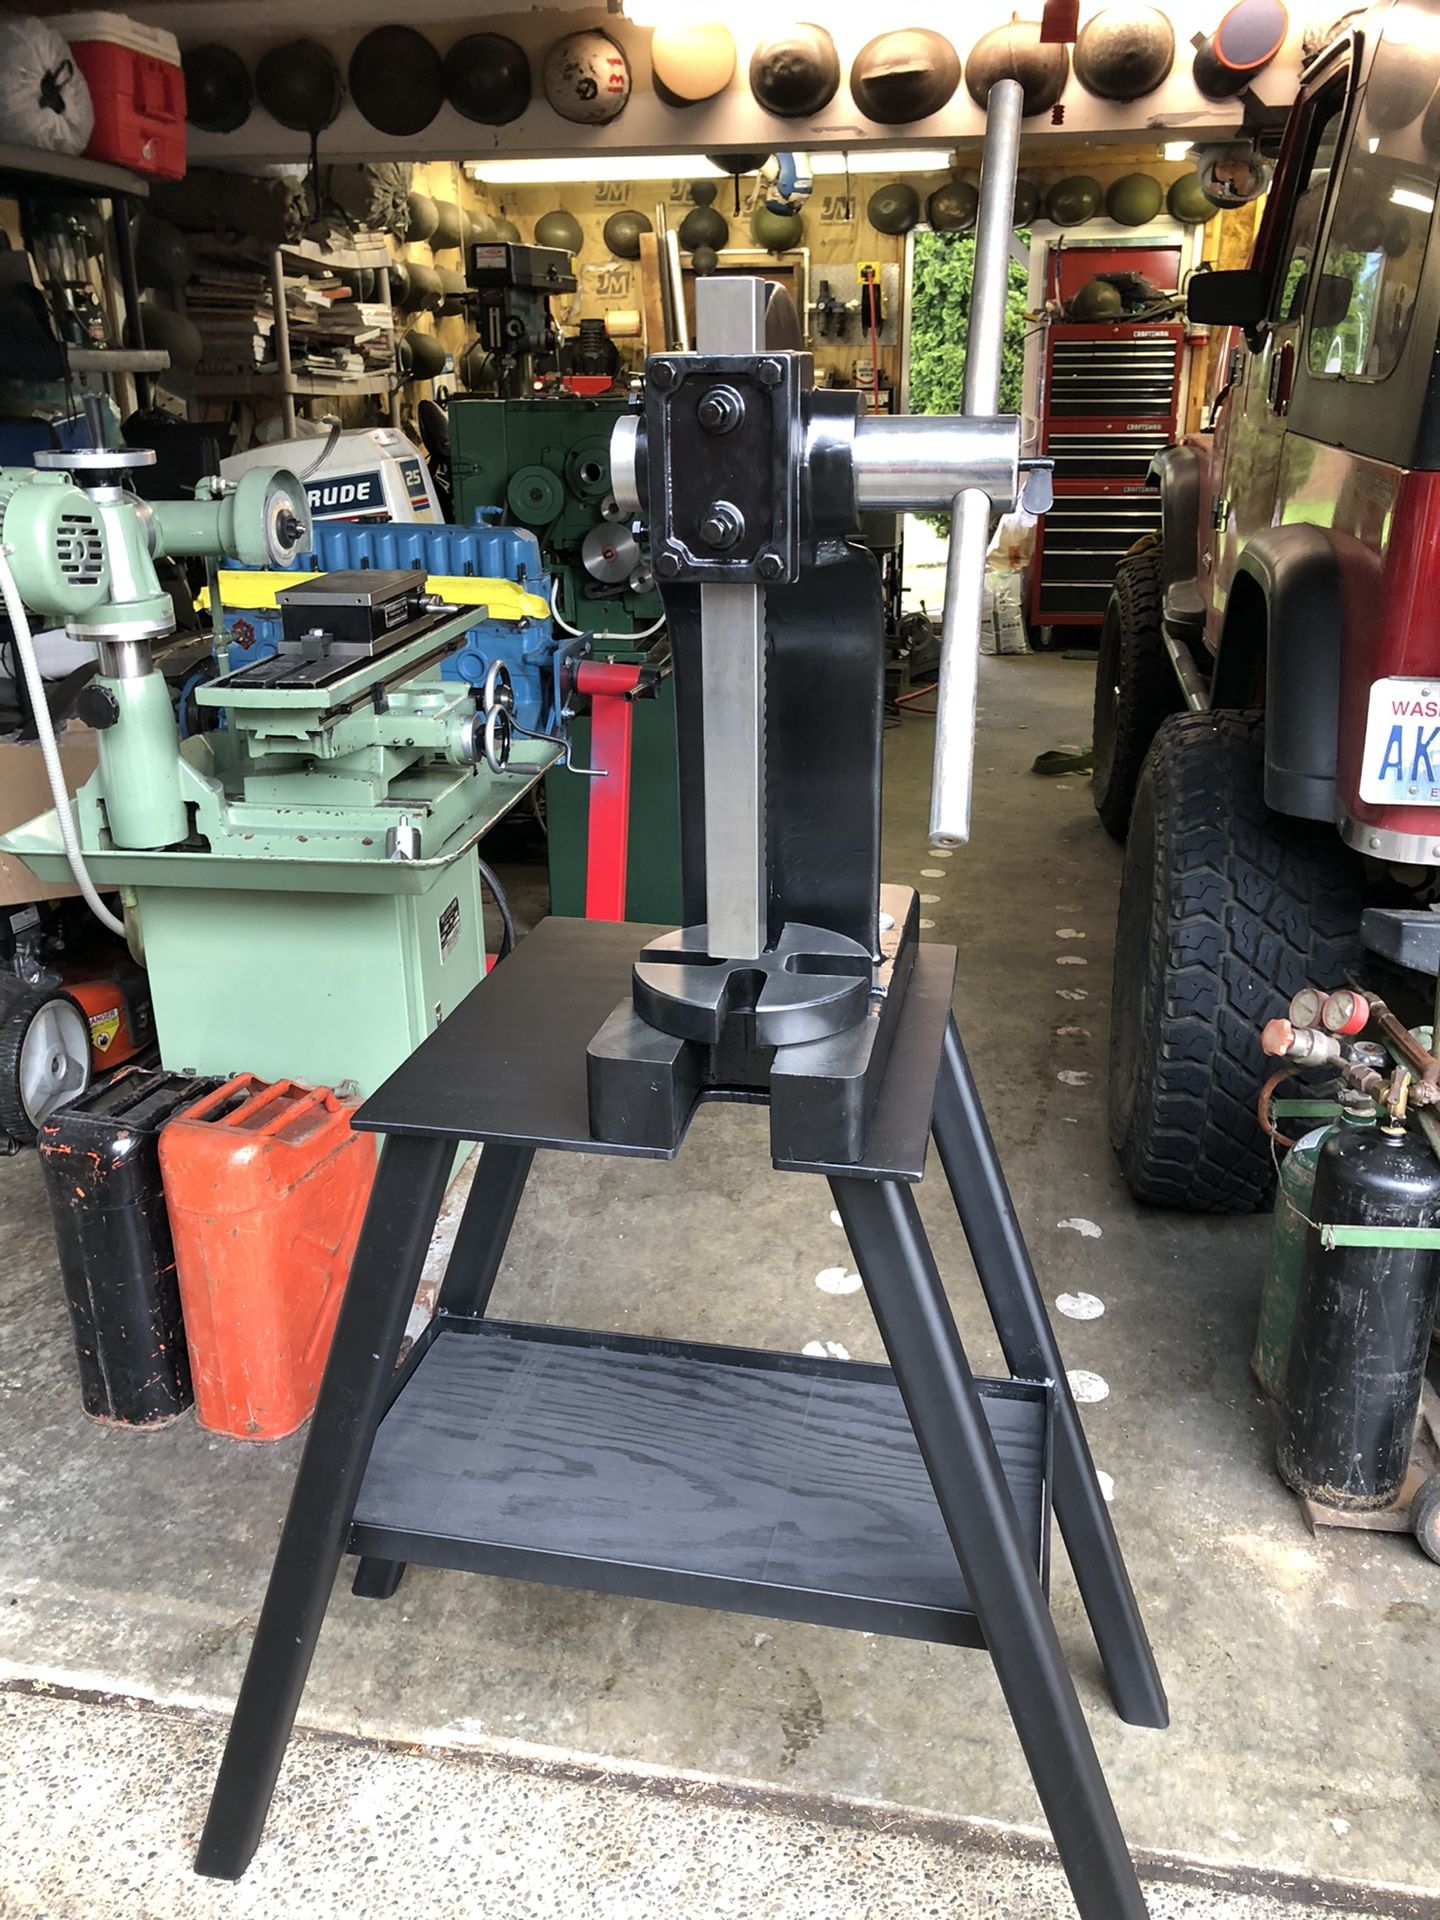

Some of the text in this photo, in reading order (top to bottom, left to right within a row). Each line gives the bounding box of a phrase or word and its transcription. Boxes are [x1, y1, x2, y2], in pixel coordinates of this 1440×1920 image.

[595, 182, 630, 201] JM
[597, 272, 631, 294] JM
[405, 469, 421, 486] 25
[1392, 701, 1440, 717] WAS
[1378, 725, 1440, 782] AK
